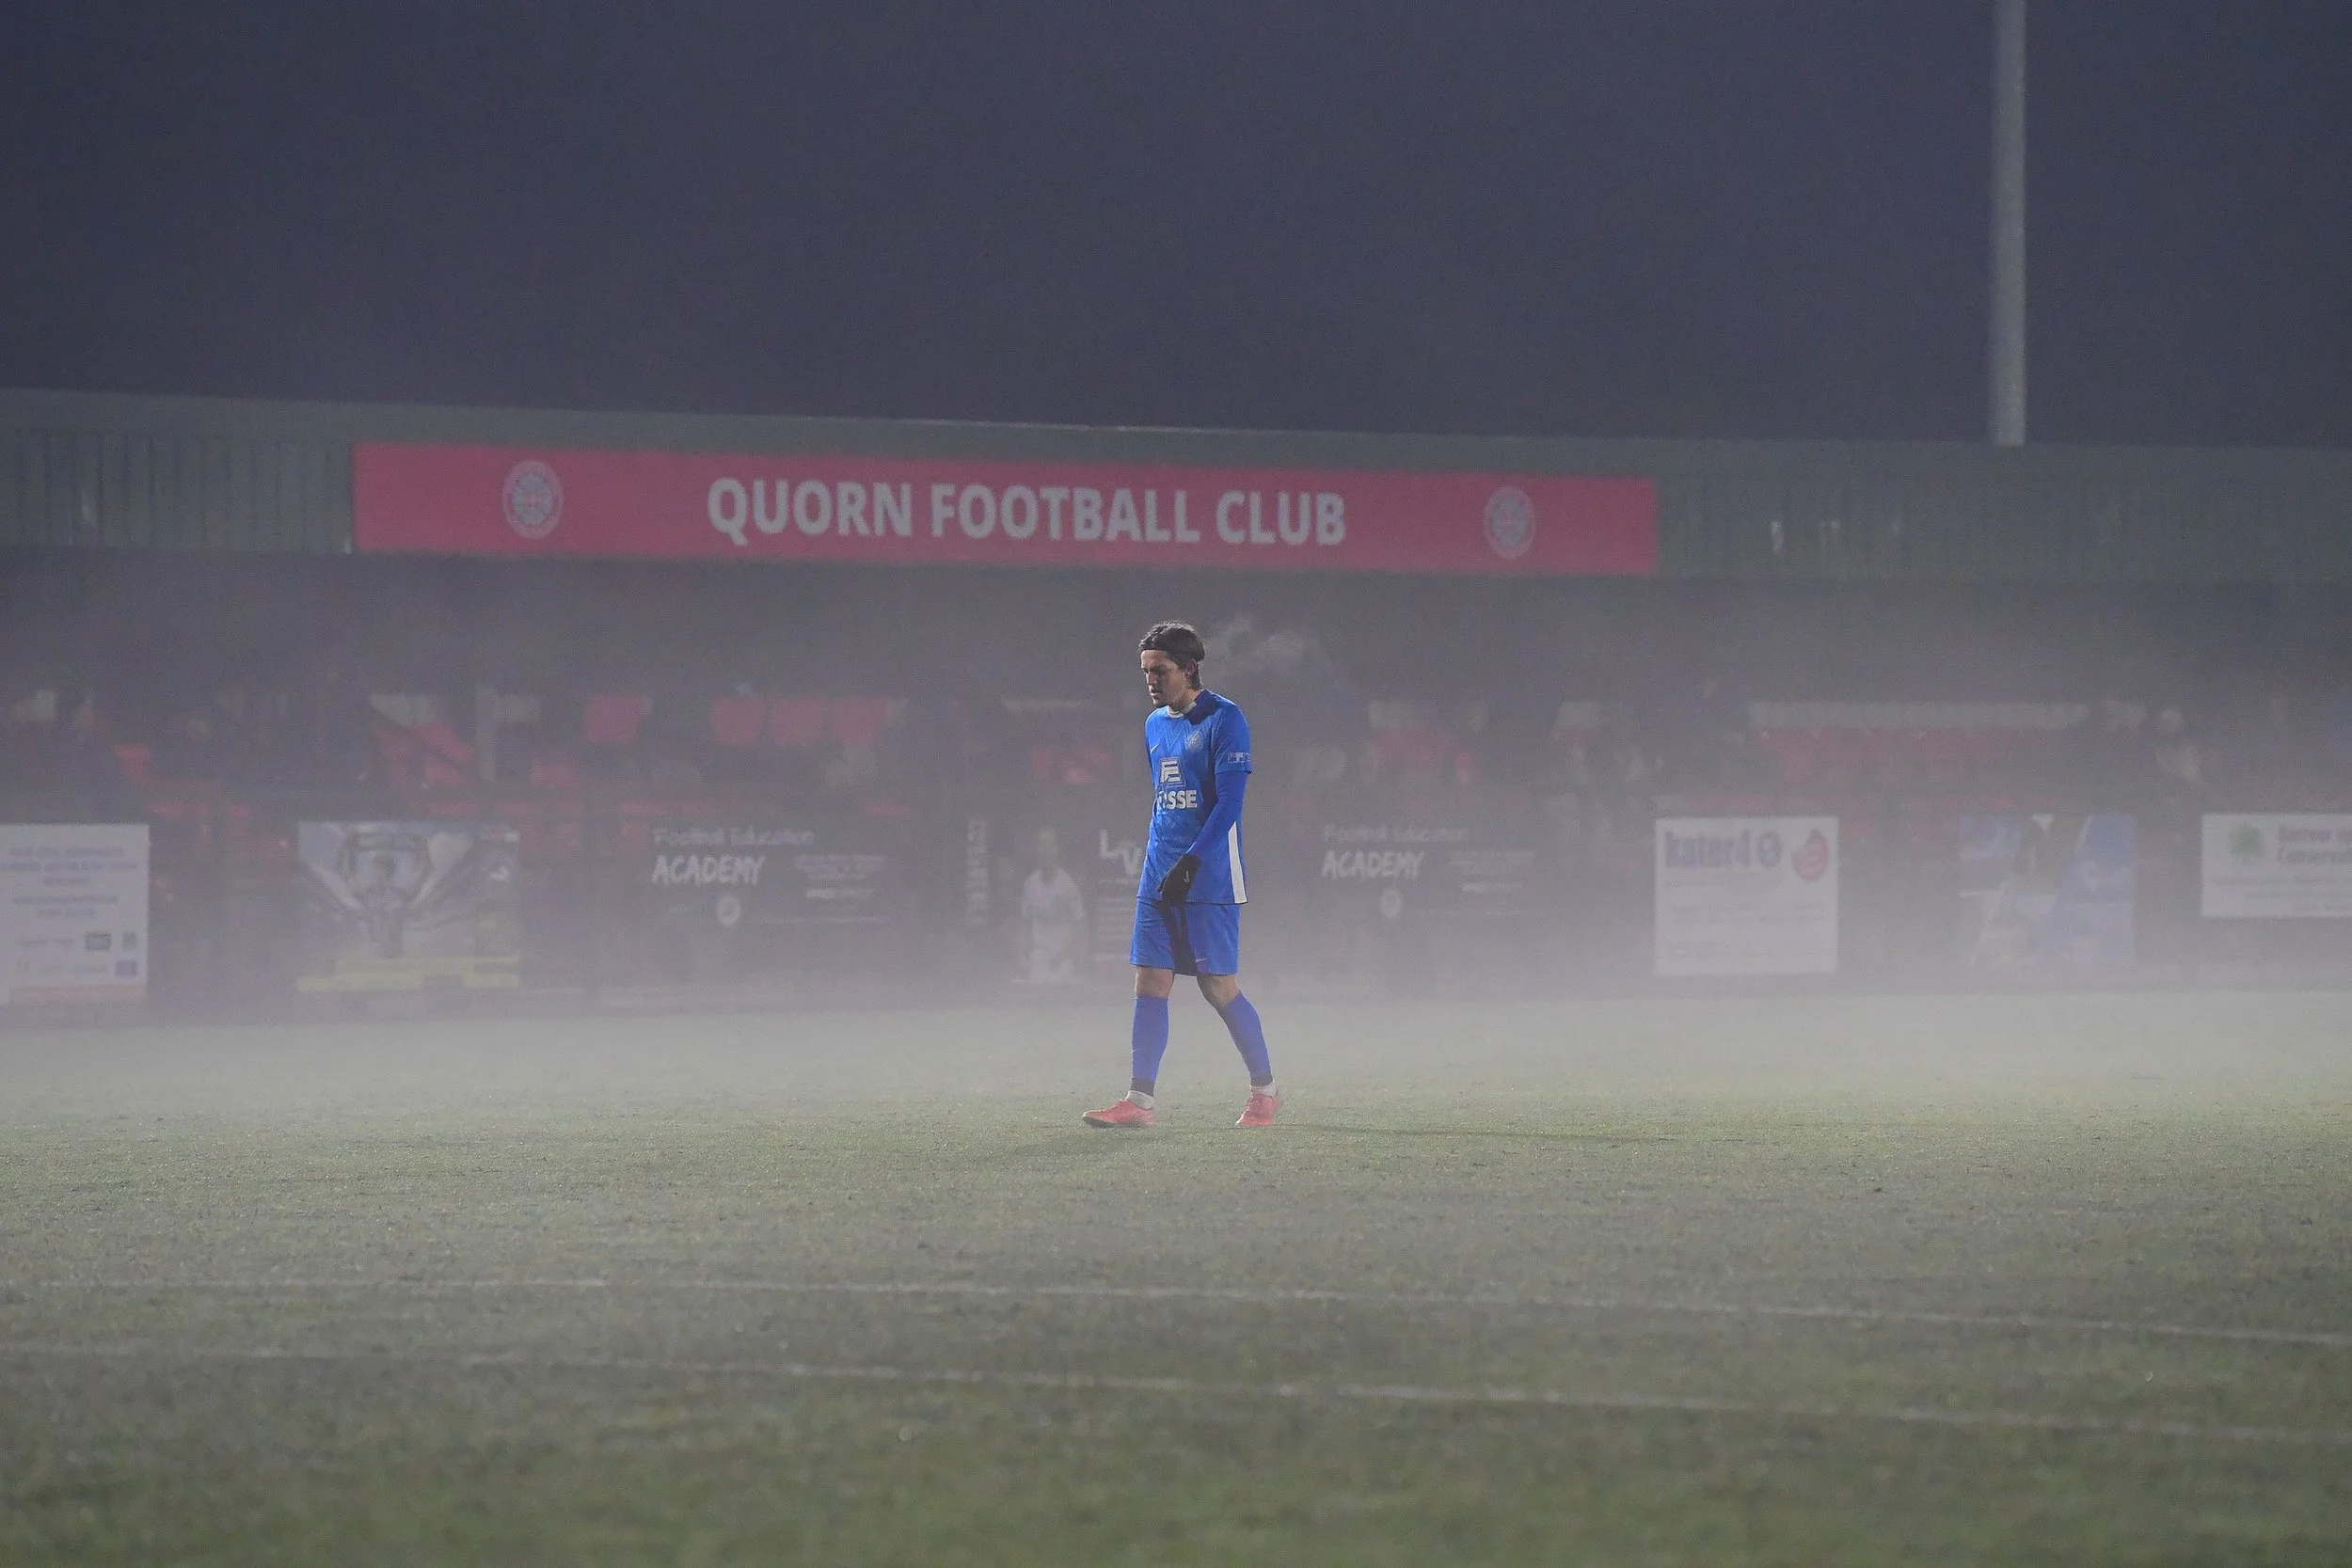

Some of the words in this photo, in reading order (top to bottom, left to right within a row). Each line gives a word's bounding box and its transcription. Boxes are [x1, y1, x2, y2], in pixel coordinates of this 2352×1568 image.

[707, 477, 913, 547] QUORN
[931, 483, 1201, 545] FOOTBALL
[1216, 490, 1347, 546] CLUB
[651, 853, 767, 886] ACADEMY
[1321, 849, 1425, 881] ACADEMY
